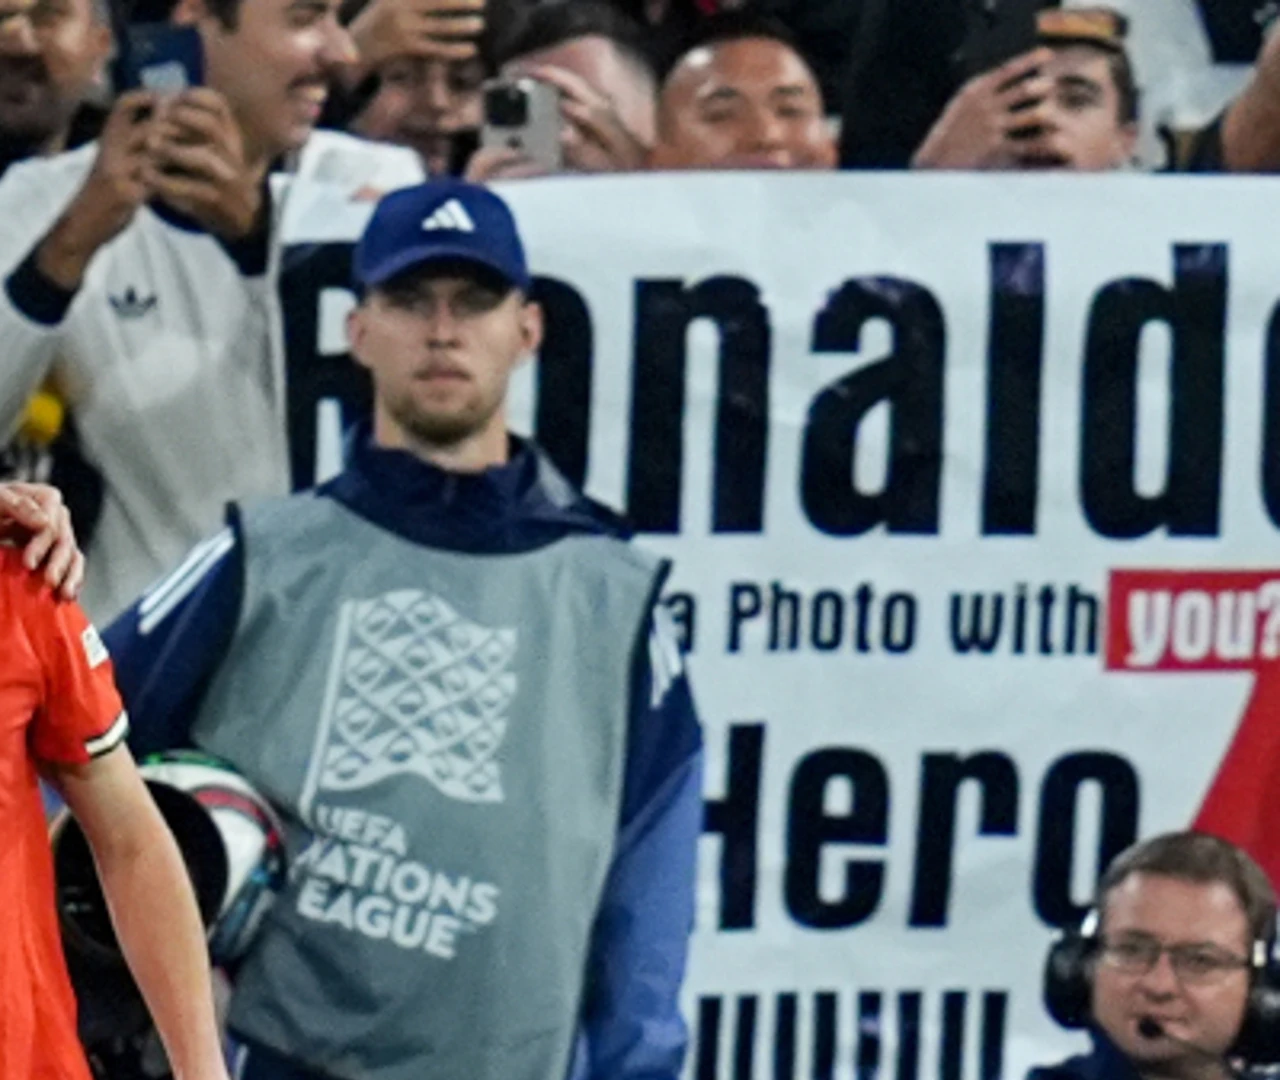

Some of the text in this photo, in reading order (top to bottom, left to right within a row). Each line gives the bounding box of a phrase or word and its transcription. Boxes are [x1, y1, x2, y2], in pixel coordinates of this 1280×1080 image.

[279, 241, 1280, 540] Rnald
[725, 580, 918, 655] Photo
[948, 580, 1100, 655] with
[315, 803, 408, 857] UEFA
[698, 721, 1140, 932] Hero
[296, 877, 456, 961] EAGUE
